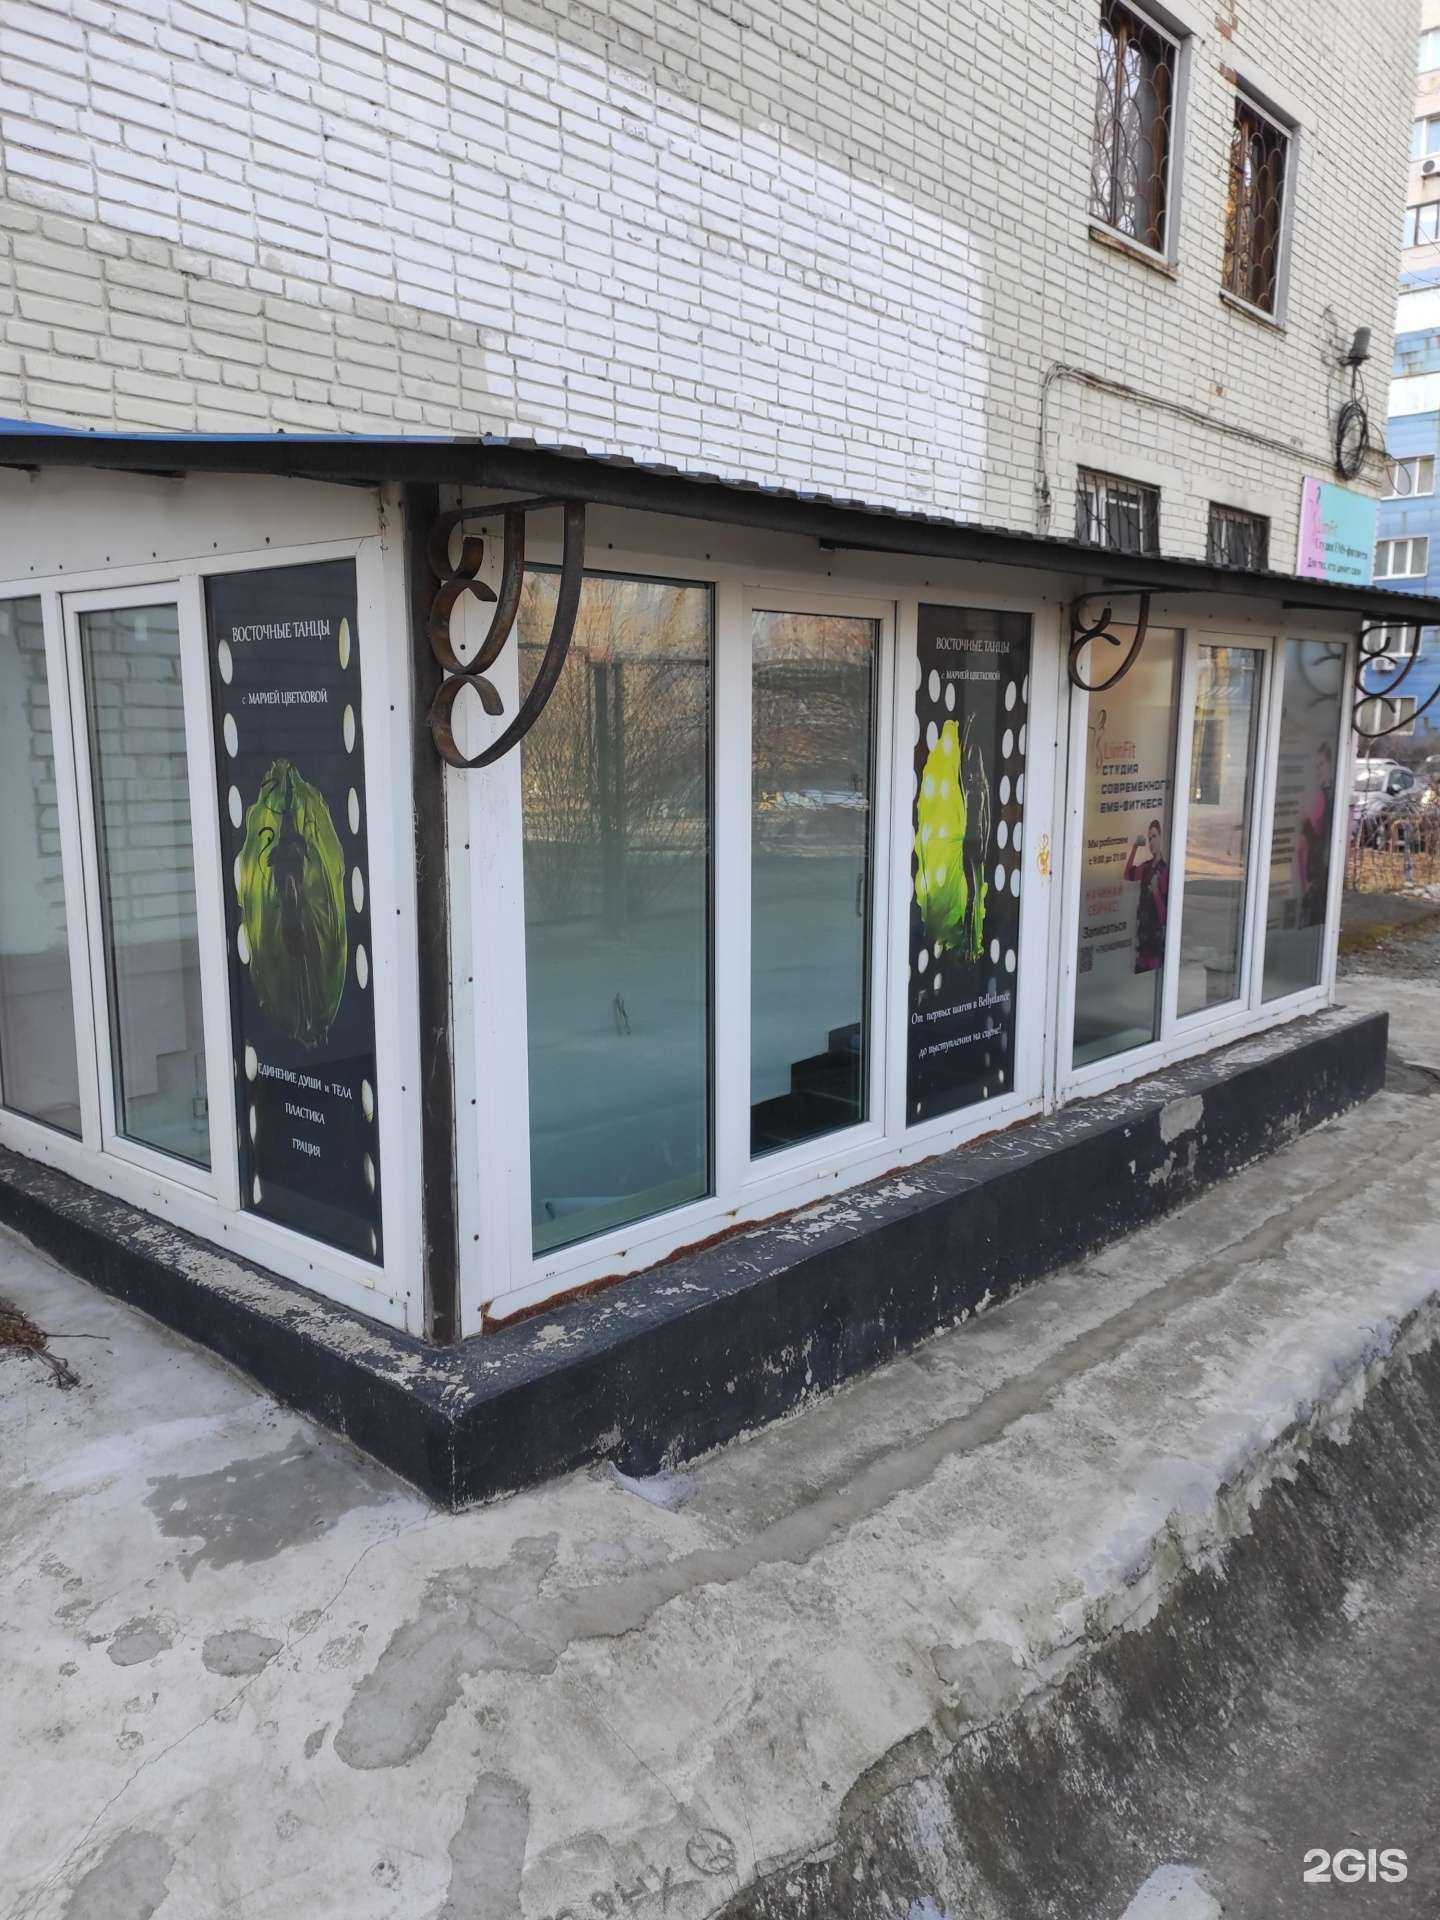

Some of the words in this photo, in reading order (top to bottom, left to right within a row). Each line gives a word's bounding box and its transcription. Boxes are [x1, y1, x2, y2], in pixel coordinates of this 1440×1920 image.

[232, 621, 292, 642] ВОСТОЧНЫЕ
[294, 619, 330, 641] ТАНЦЫ
[936, 637, 983, 652] ВОСТОЧНЫЕ
[983, 640, 1010, 654] ТАНЦЫ
[248, 690, 280, 705] МАРИЕЙ
[281, 688, 328, 706] ЦВЕТКОВОЙ
[1102, 763, 1139, 776] СТУДИЯ
[1101, 779, 1171, 795] СОВРЕМЕННОГО
[911, 1012, 924, 1025] От
[926, 1007, 951, 1022] первых
[952, 1001, 972, 1014] шагов
[919, 1048, 928, 1061] до
[928, 1036, 972, 1054] выступления
[973, 1032, 981, 1041] на
[257, 1062, 297, 1084] ЕДИНЕНИЕ
[298, 1074, 322, 1092] ДУШИ
[332, 1083, 352, 1100] ТЕЛА
[285, 1102, 325, 1125] ПЛАСТИКА
[292, 1137, 321, 1157] ГРАЦИЯ
